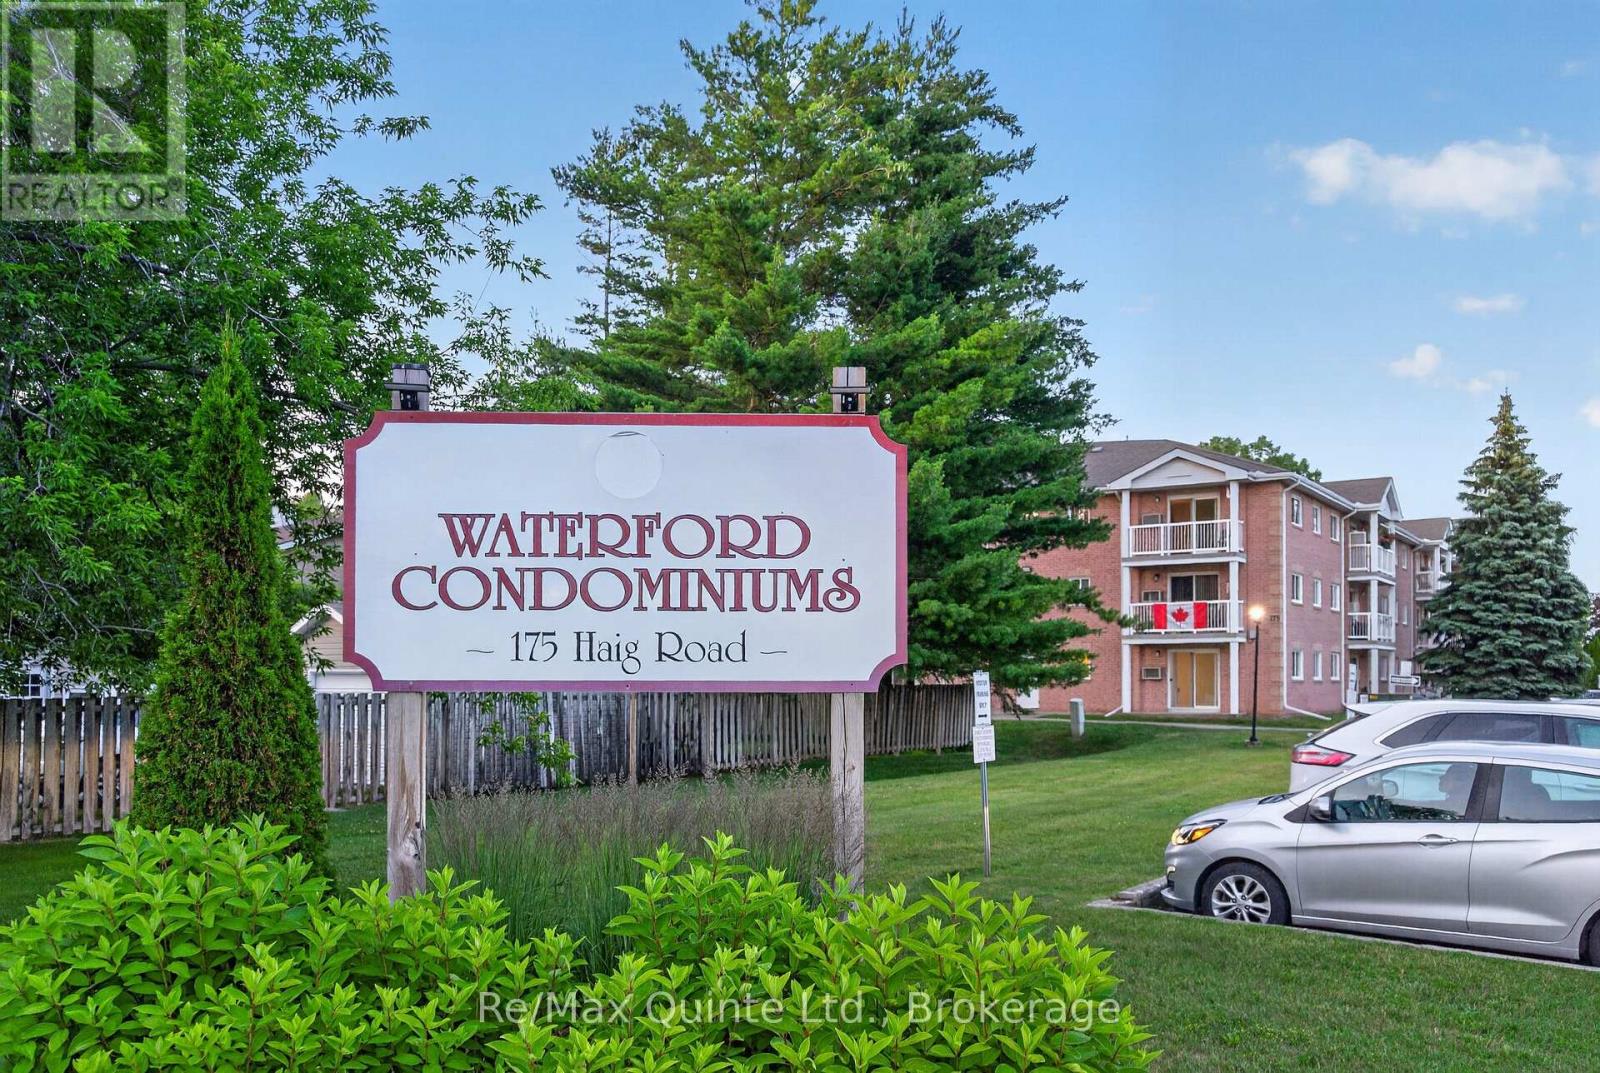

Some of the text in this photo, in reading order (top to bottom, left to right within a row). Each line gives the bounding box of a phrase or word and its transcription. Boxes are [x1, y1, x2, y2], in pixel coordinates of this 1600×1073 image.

[437, 511, 812, 561] WATERFORD
[391, 565, 862, 613] CONDOMINIUMS
[509, 629, 749, 675] 175 Haig Road
